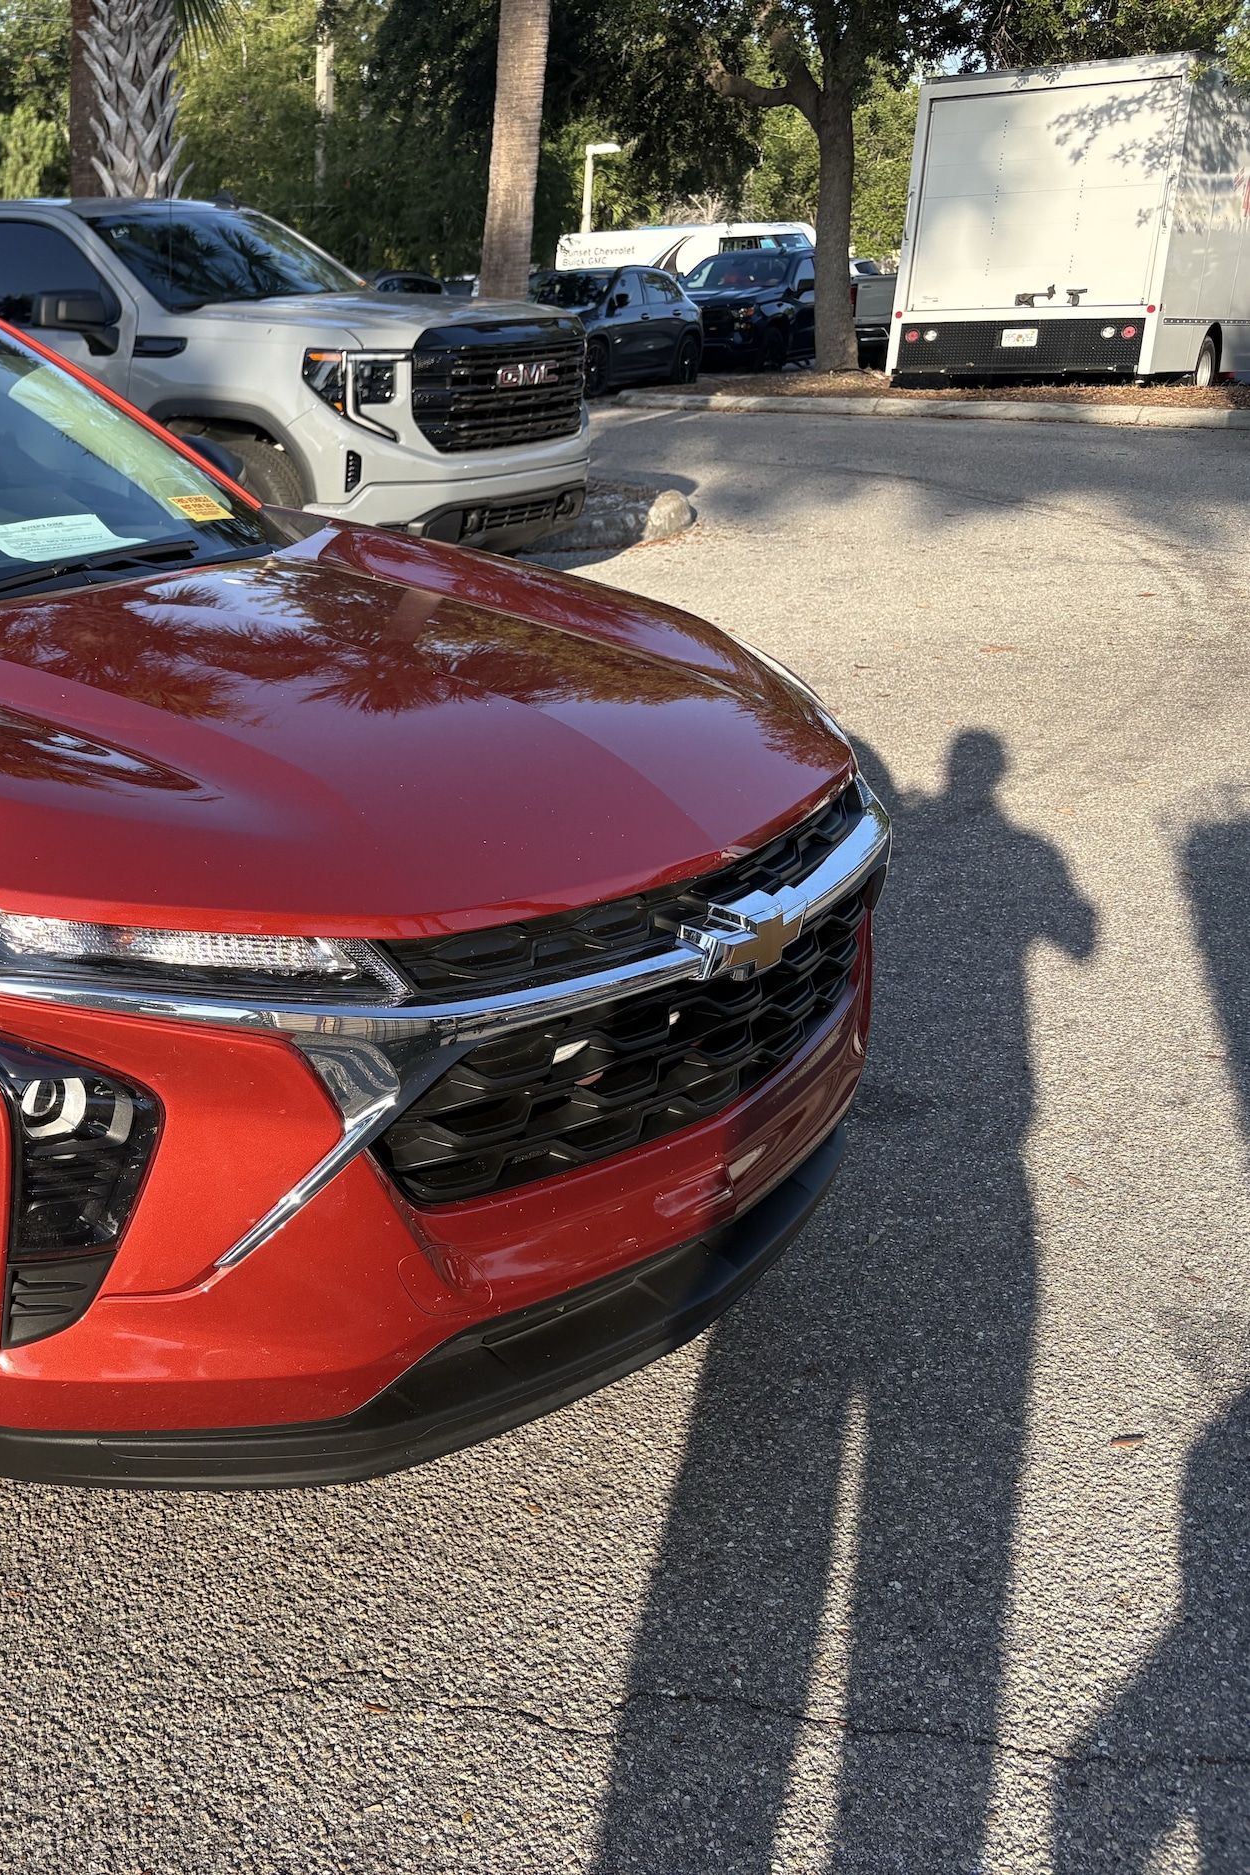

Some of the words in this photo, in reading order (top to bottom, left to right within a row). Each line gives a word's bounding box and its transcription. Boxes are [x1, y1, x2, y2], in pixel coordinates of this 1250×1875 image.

[593, 246, 635, 256] Chevrolet
[562, 257, 585, 267] Buick
[588, 256, 607, 265] GMC
[495, 360, 559, 387] GMC
